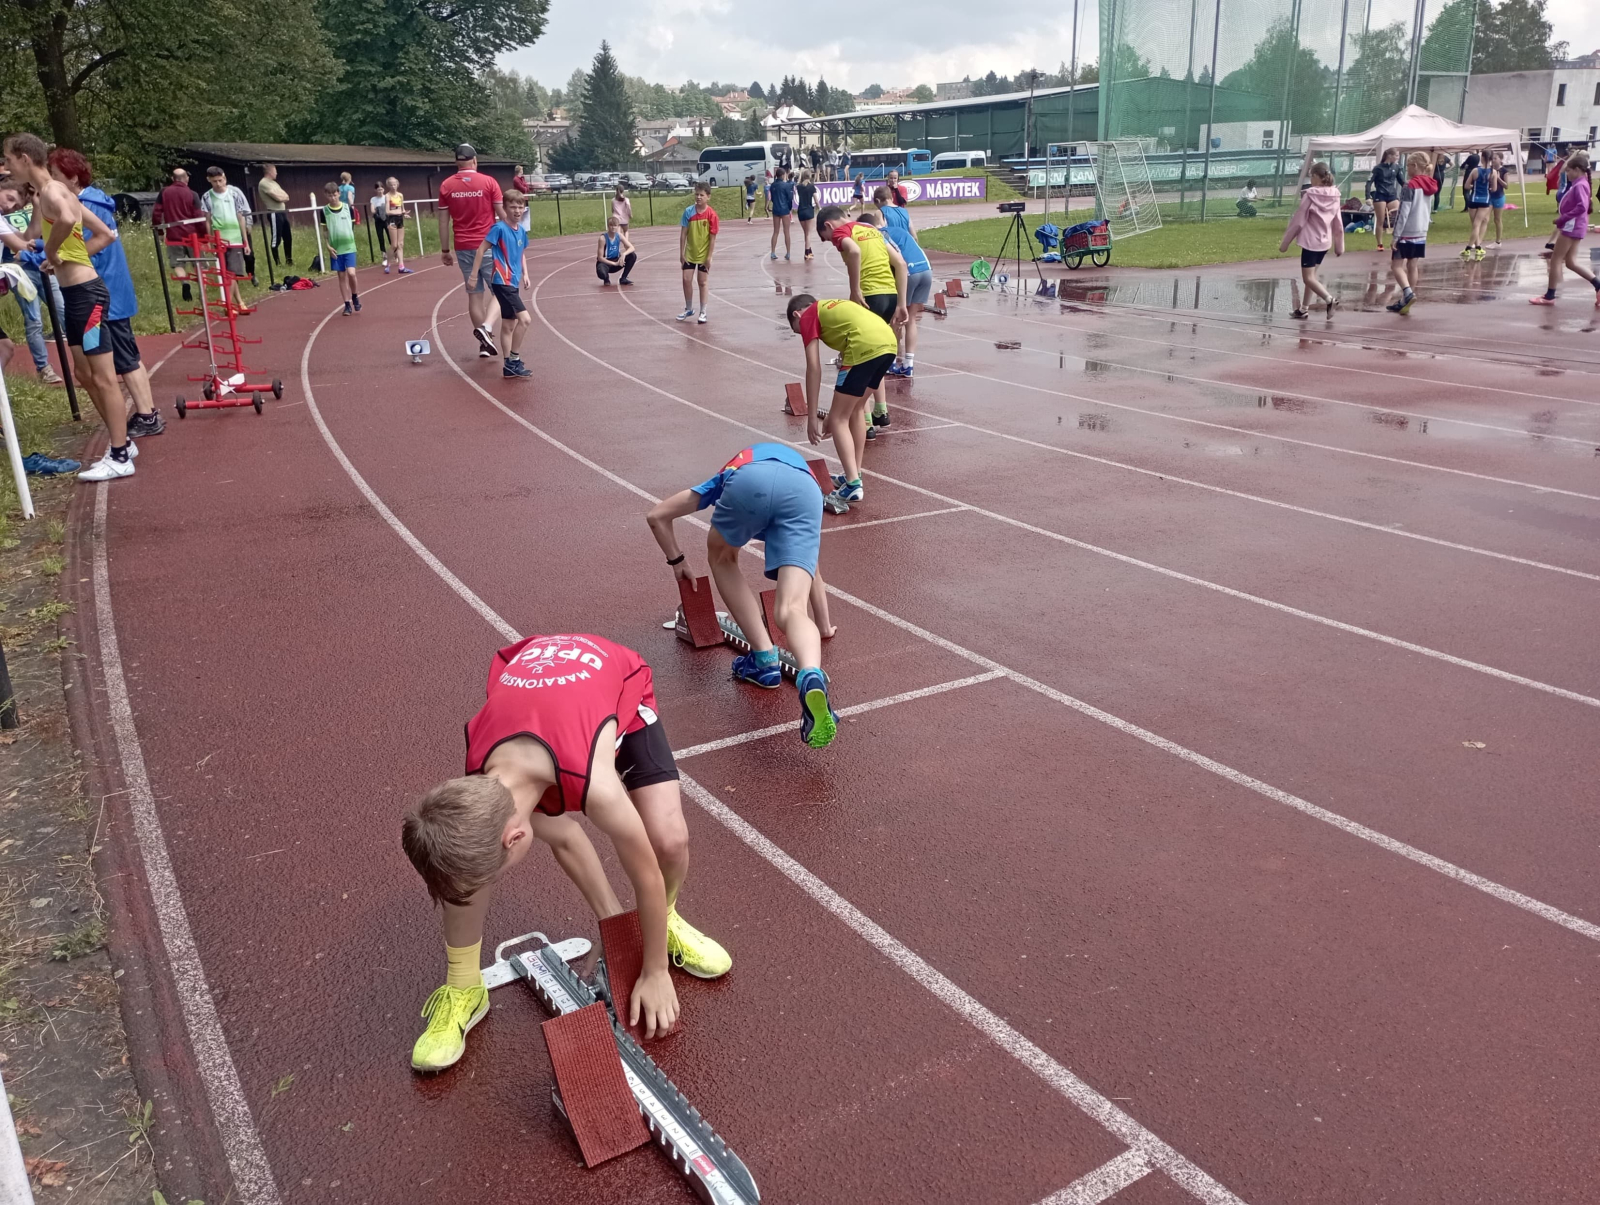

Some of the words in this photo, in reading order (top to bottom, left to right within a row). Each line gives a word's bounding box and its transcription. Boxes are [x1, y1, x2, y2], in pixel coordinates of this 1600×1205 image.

[451, 190, 483, 198] ROZHODČÍ
[823, 185, 880, 204] KOUPLN
[926, 181, 980, 199] NÁBYTEK
[527, 954, 548, 976] GUMI
